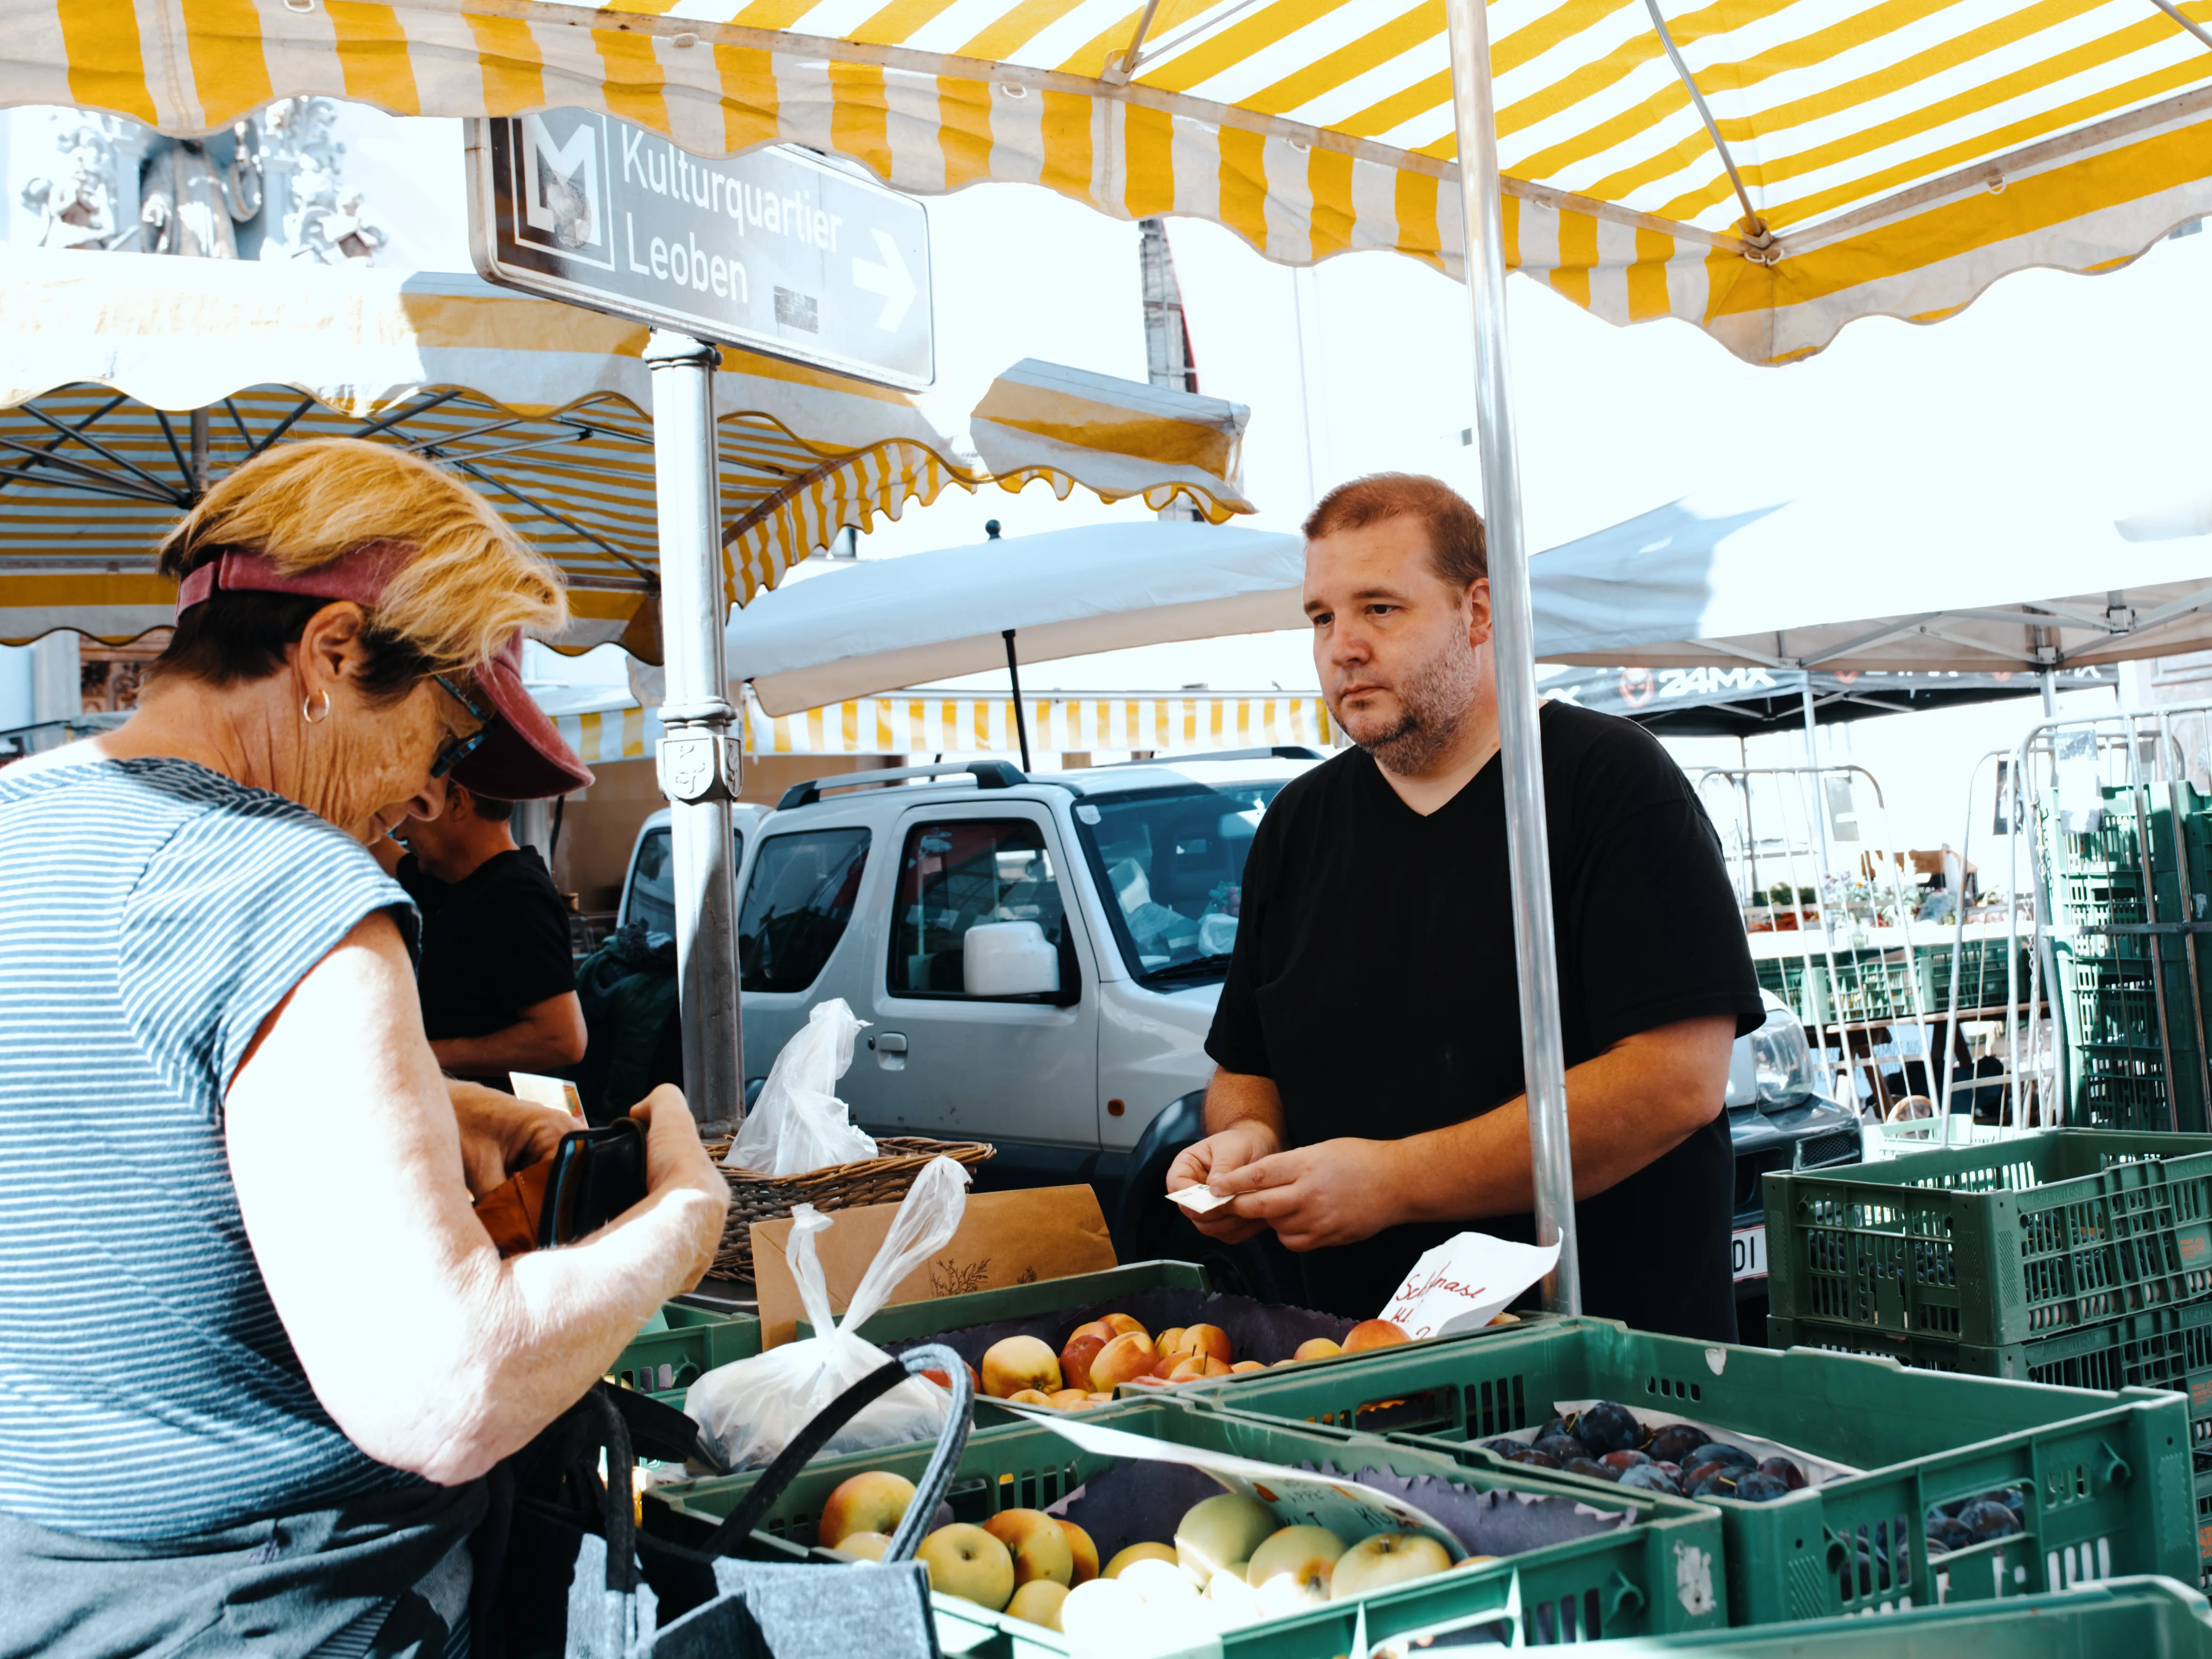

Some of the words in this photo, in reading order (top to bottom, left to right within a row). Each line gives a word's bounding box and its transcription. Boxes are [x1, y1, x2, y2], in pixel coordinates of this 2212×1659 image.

[622, 124, 843, 252] Kulturquartier
[626, 212, 748, 304] Leoben
[1658, 667, 1777, 698] 24MX
